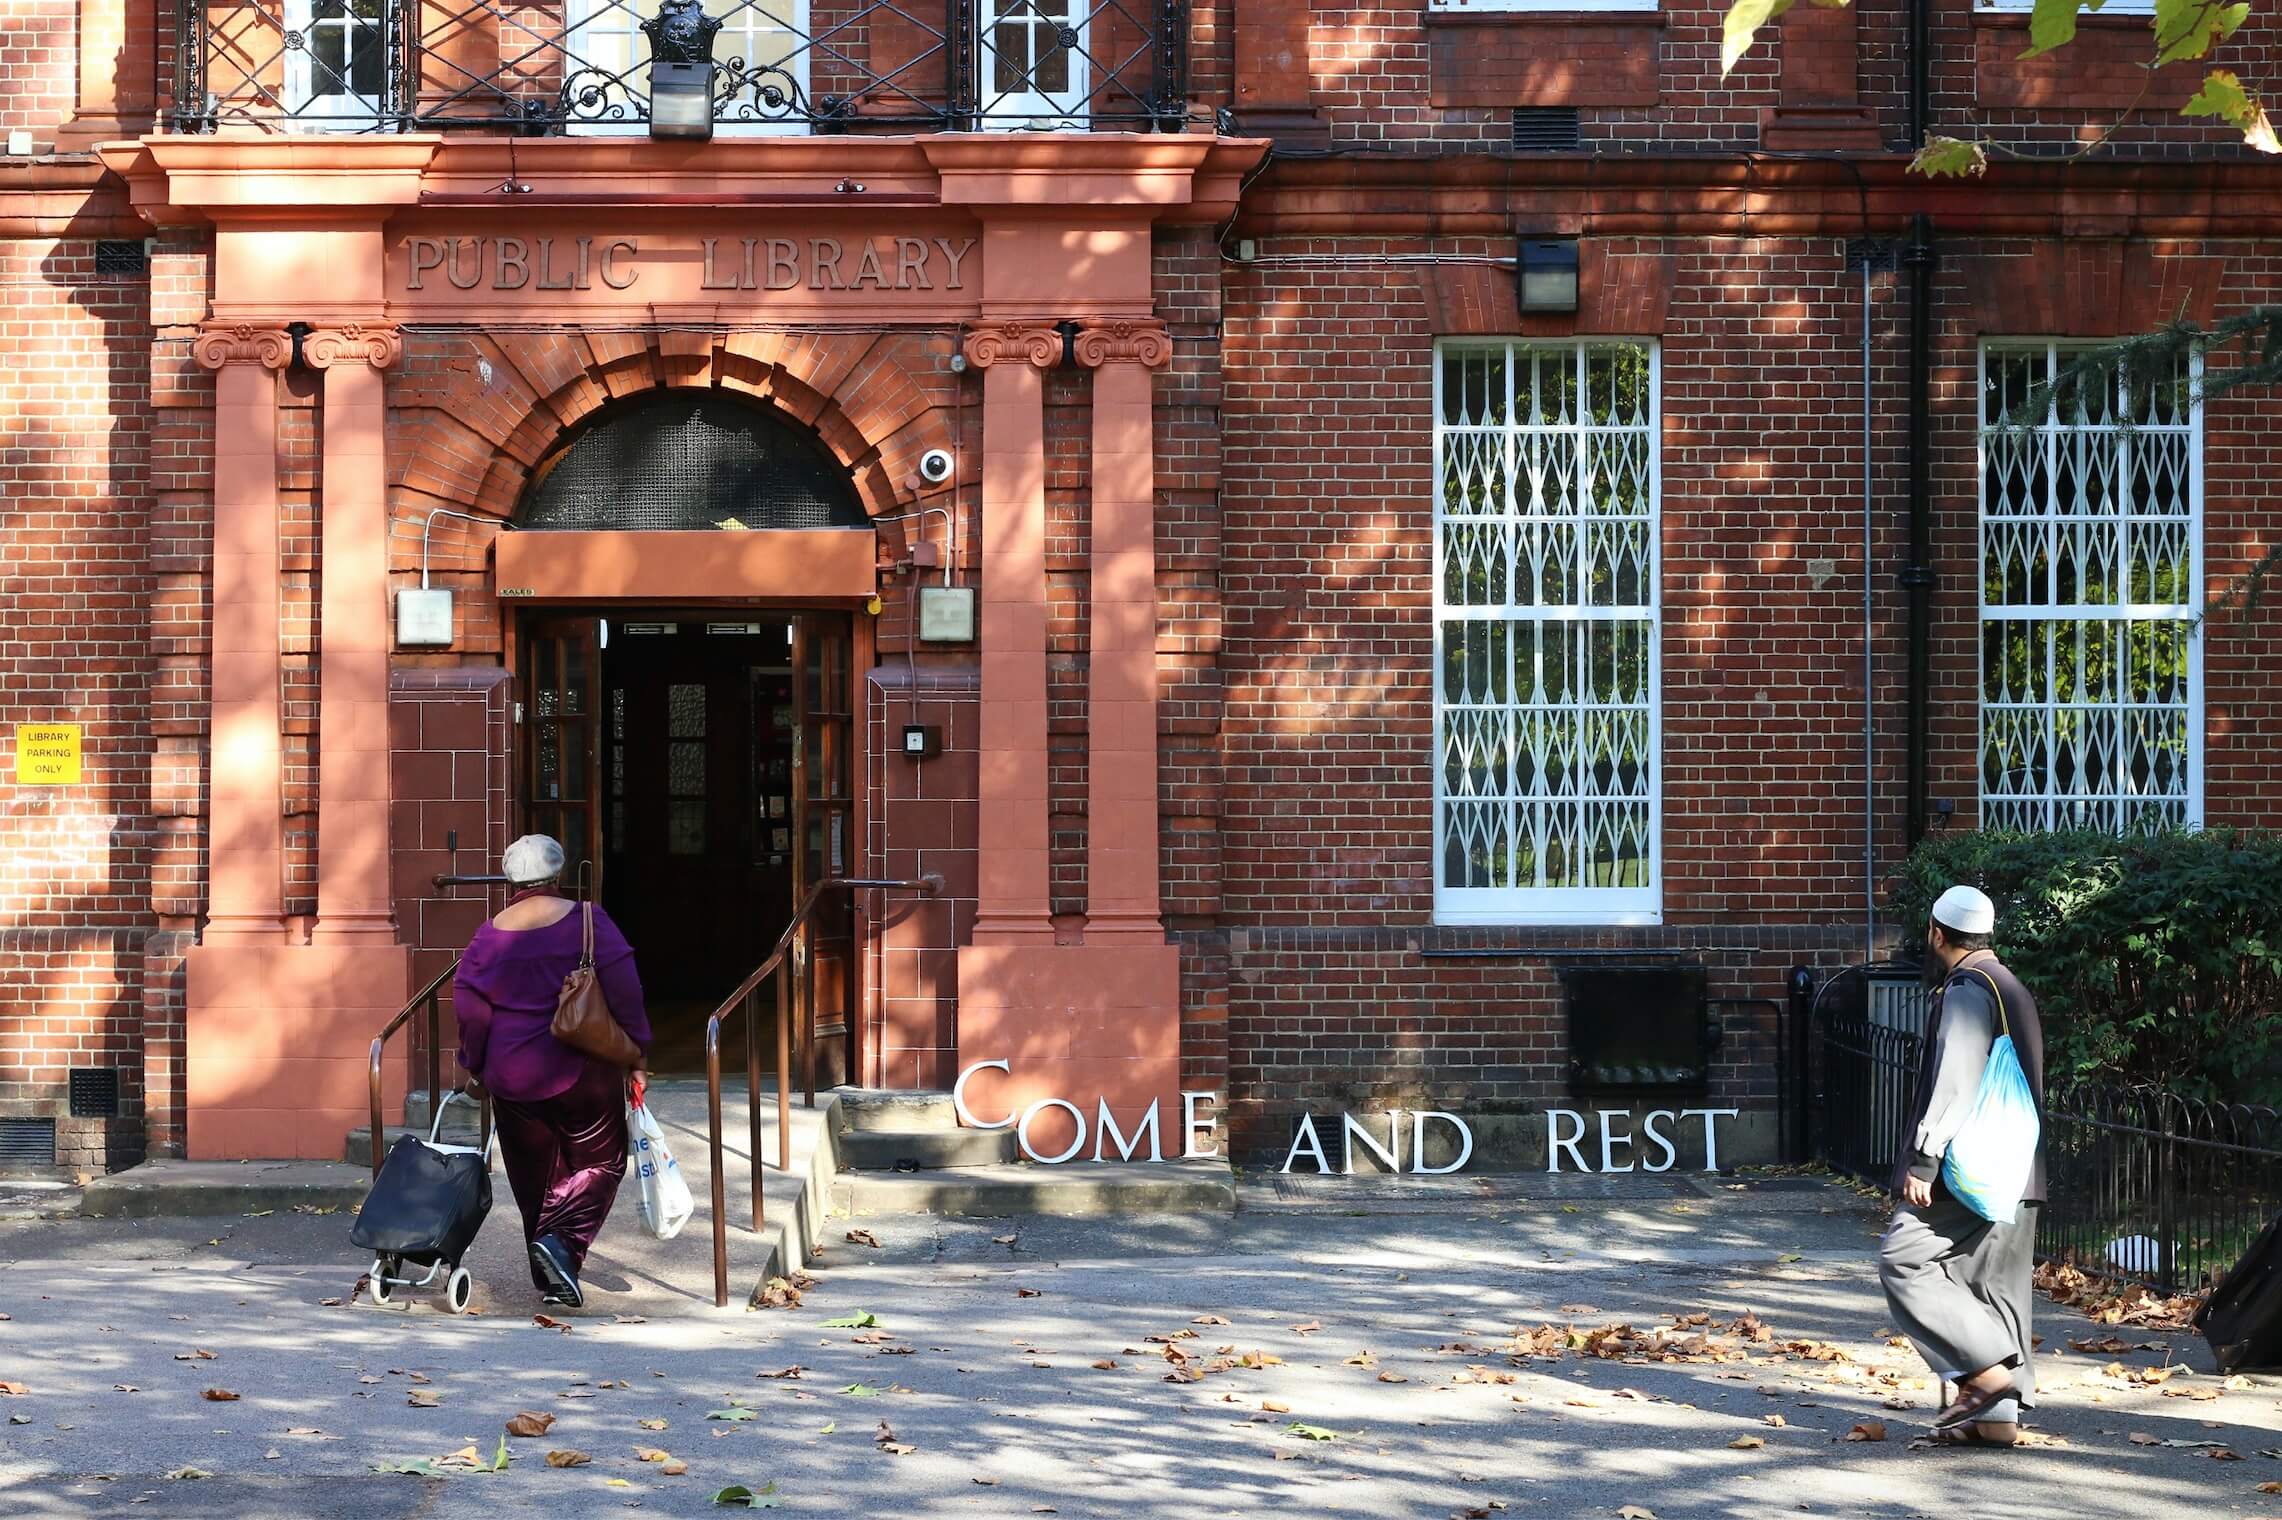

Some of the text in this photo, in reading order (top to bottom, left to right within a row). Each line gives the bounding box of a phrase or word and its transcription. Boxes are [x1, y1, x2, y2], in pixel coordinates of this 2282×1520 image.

[406, 237, 977, 291] PUBLIC LIBRARY
[28, 732, 70, 741] LIBRARY
[26, 749, 71, 758] PARKING
[34, 764, 62, 774] ONLY
[953, 1058, 1740, 1175] COME AND REST
